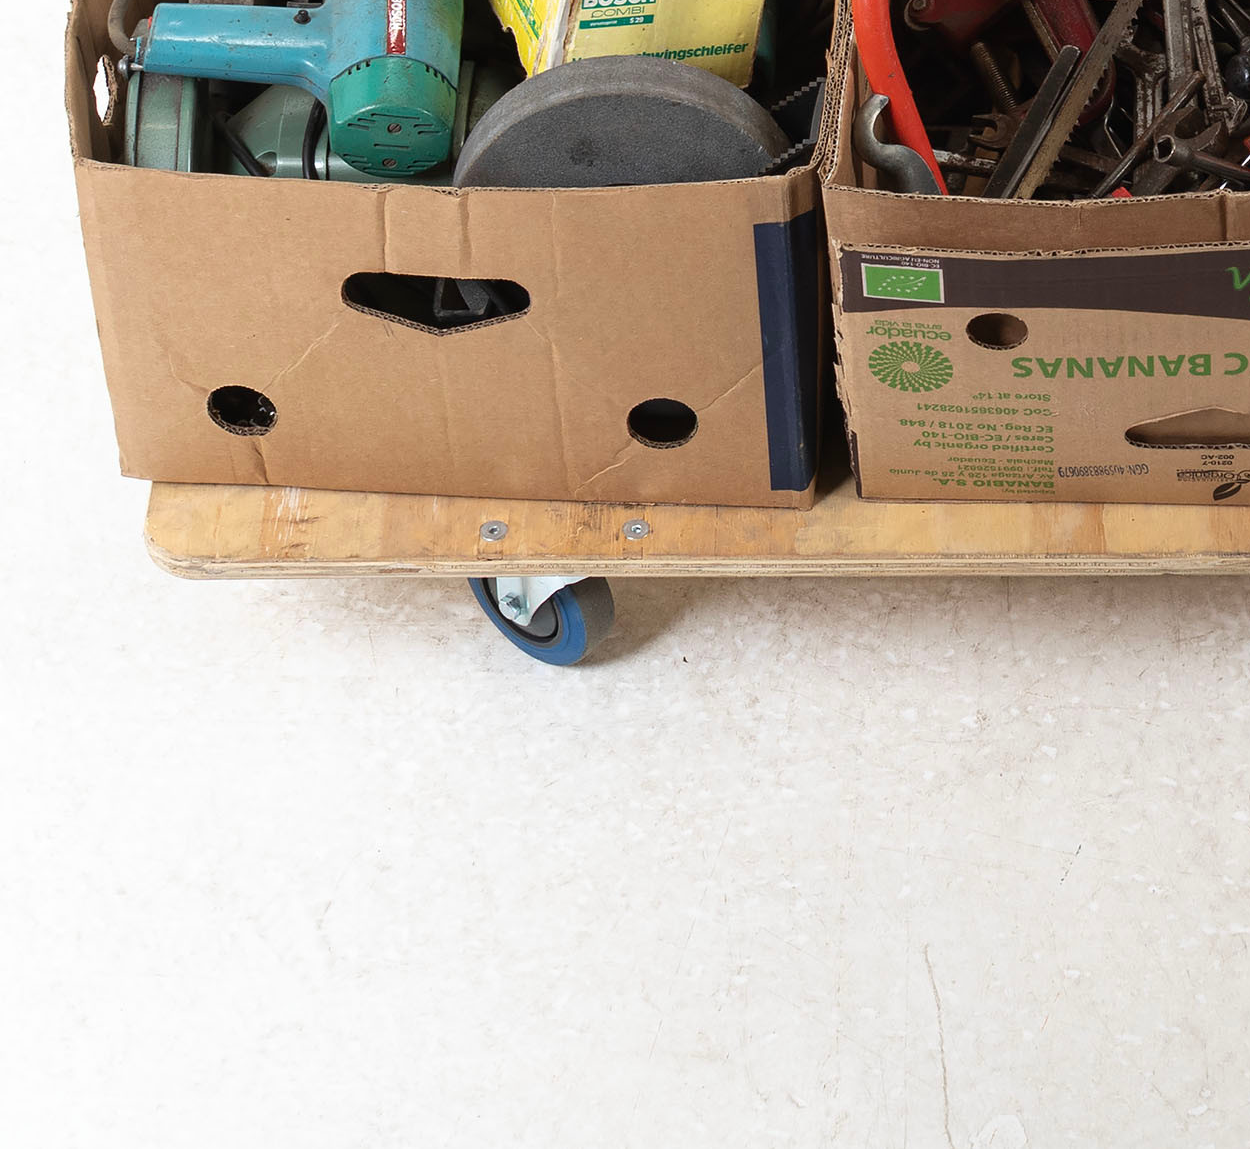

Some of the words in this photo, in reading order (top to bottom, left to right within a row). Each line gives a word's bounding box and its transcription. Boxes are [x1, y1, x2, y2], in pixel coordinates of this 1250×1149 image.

[591, 6, 645, 18] COMBI
[861, 253, 910, 261] AGRICULTURE
[865, 325, 951, 341] ecuador
[1010, 353, 1211, 378] BANANAS
[997, 392, 1010, 400] at
[1015, 392, 1050, 401] Store
[898, 418, 925, 427] 848
[938, 420, 970, 430] 2018
[999, 422, 1031, 432] Reg.
[921, 430, 1001, 441] EC-BIO-140
[1014, 434, 1053, 442] Ceres
[913, 439, 930, 447] by
[933, 441, 987, 451] organic
[992, 444, 1053, 452] Certified
[947, 456, 995, 464] Ecuador
[932, 478, 966, 486] S.A.
[972, 479, 1054, 487] BANABIO
